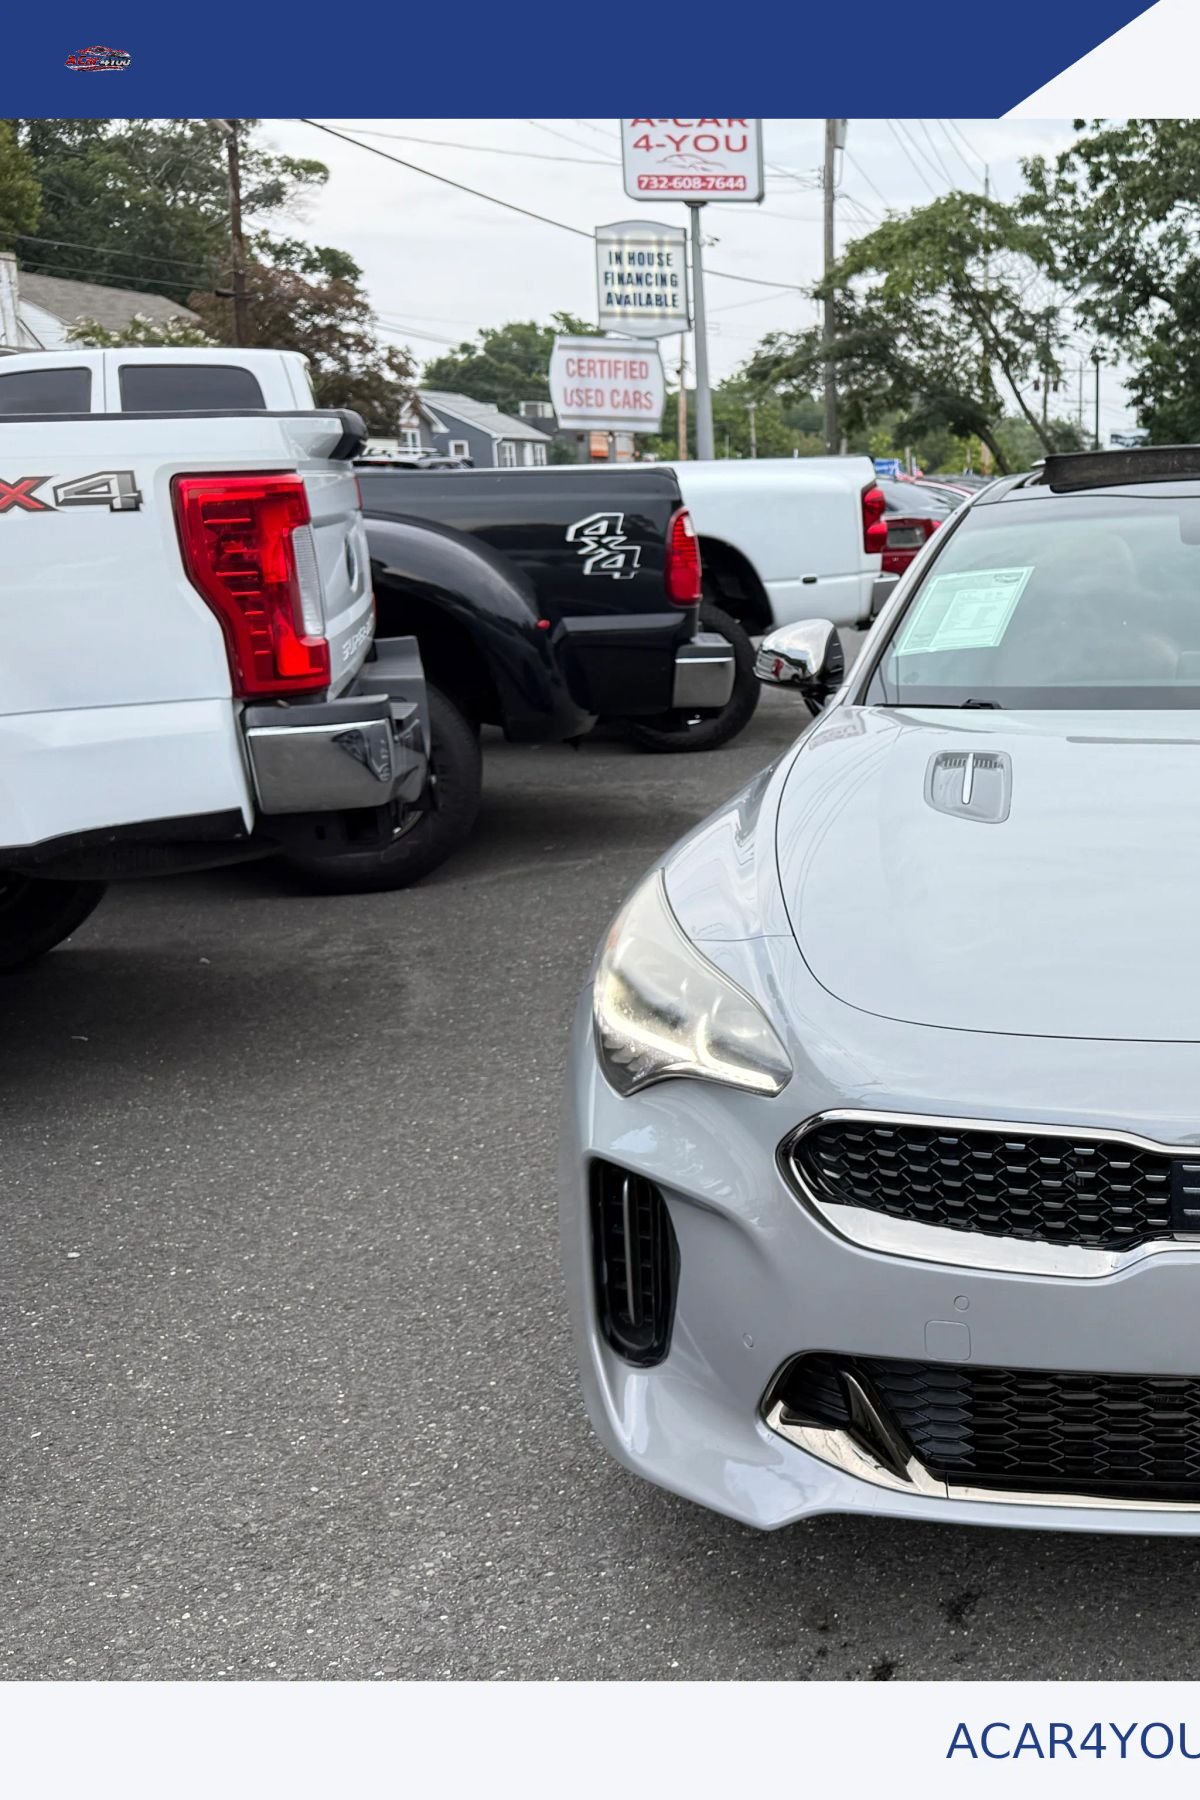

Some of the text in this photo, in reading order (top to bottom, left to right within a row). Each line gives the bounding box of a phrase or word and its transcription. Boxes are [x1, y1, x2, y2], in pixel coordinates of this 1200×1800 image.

[633, 134, 748, 153] 4-YOU
[639, 176, 746, 190] 732-608-7644
[608, 251, 673, 267] IN HOUSE
[604, 271, 679, 288] FINANCING
[606, 291, 679, 308] AVAILABLE
[566, 358, 650, 379] CERTIFIED
[563, 387, 654, 410] USED CARS
